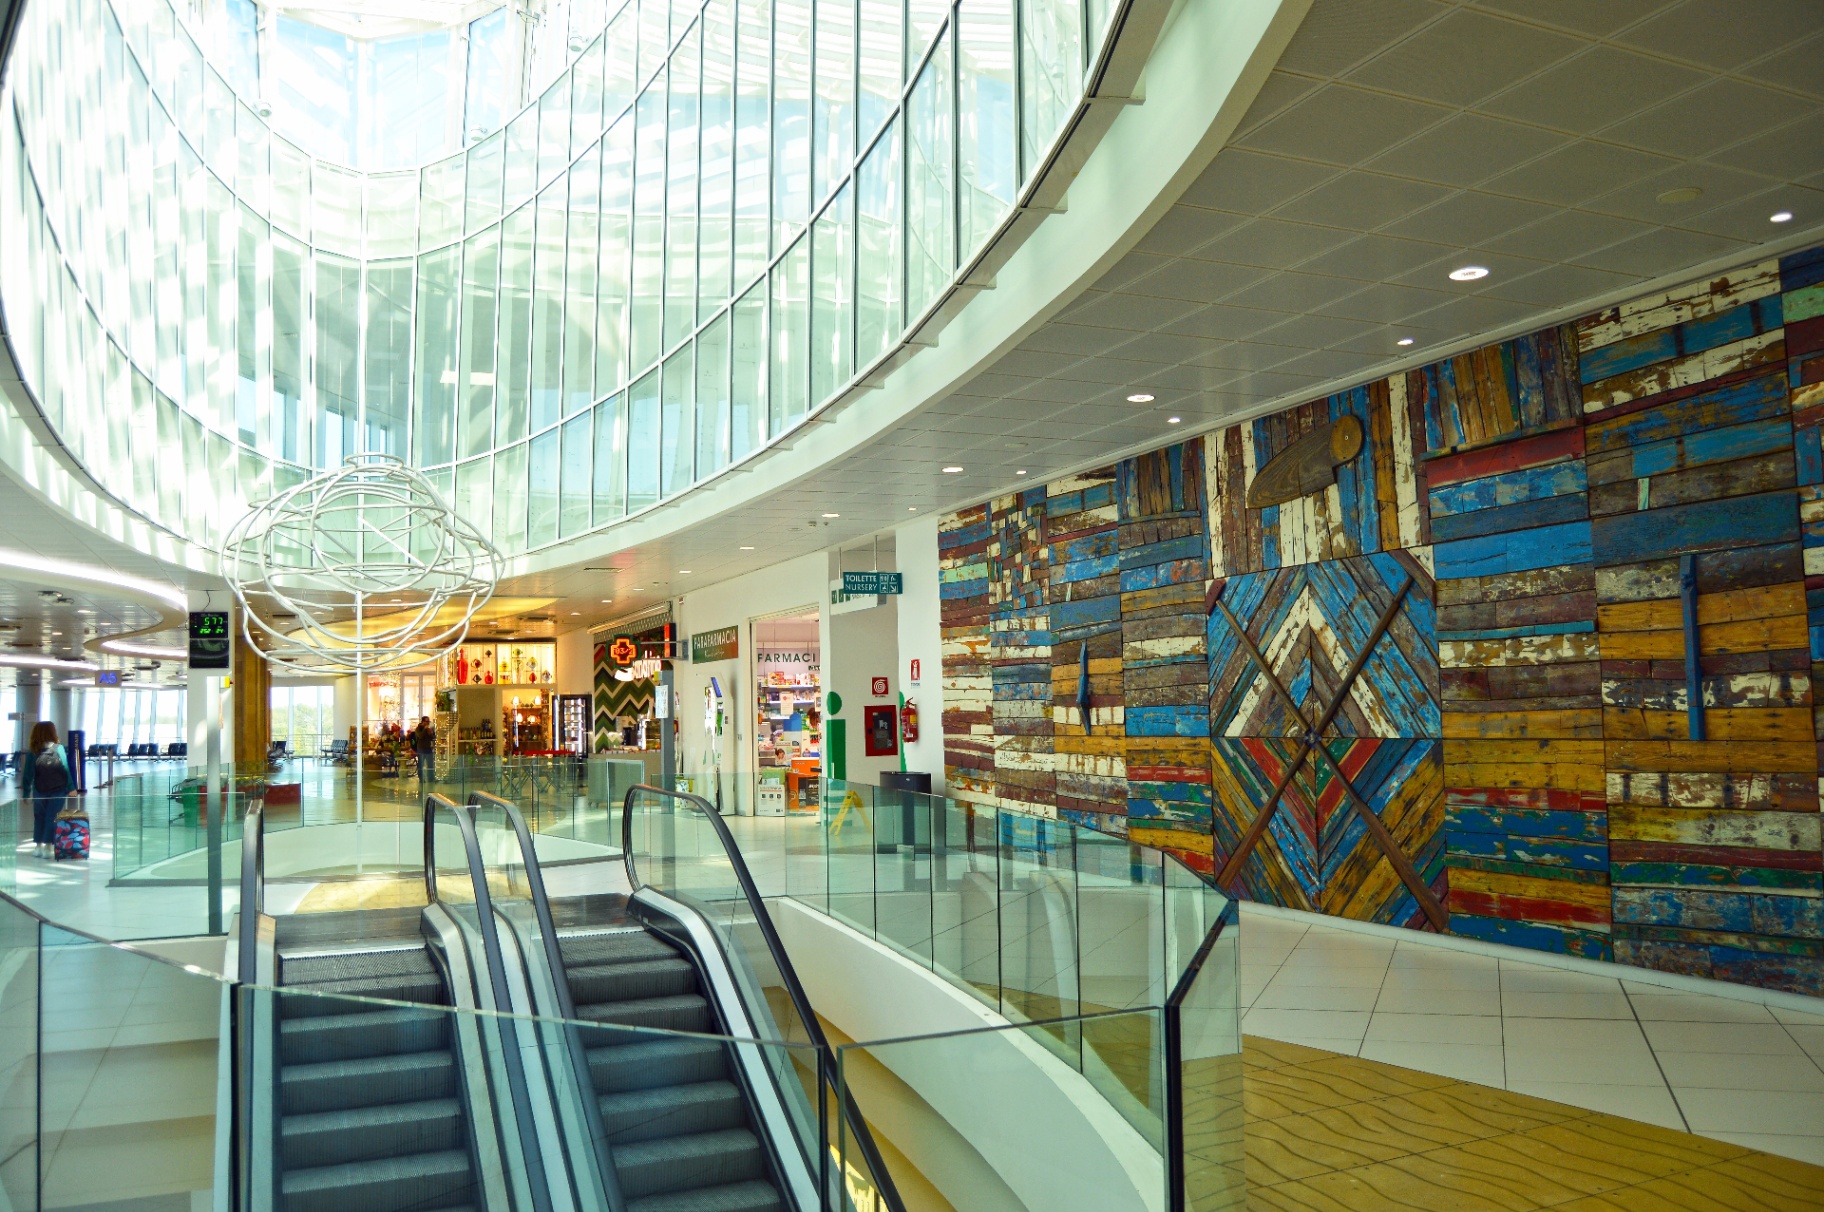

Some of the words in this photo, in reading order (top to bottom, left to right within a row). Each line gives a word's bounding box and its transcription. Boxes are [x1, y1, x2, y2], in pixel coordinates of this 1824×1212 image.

[844, 574, 877, 582] TOILETTE
[844, 583, 878, 591] NURSERY
[204, 616, 223, 625] 577
[693, 628, 736, 650] PARAFARMACIA
[757, 653, 816, 663] FARMACI
[99, 671, 118, 685] A5
